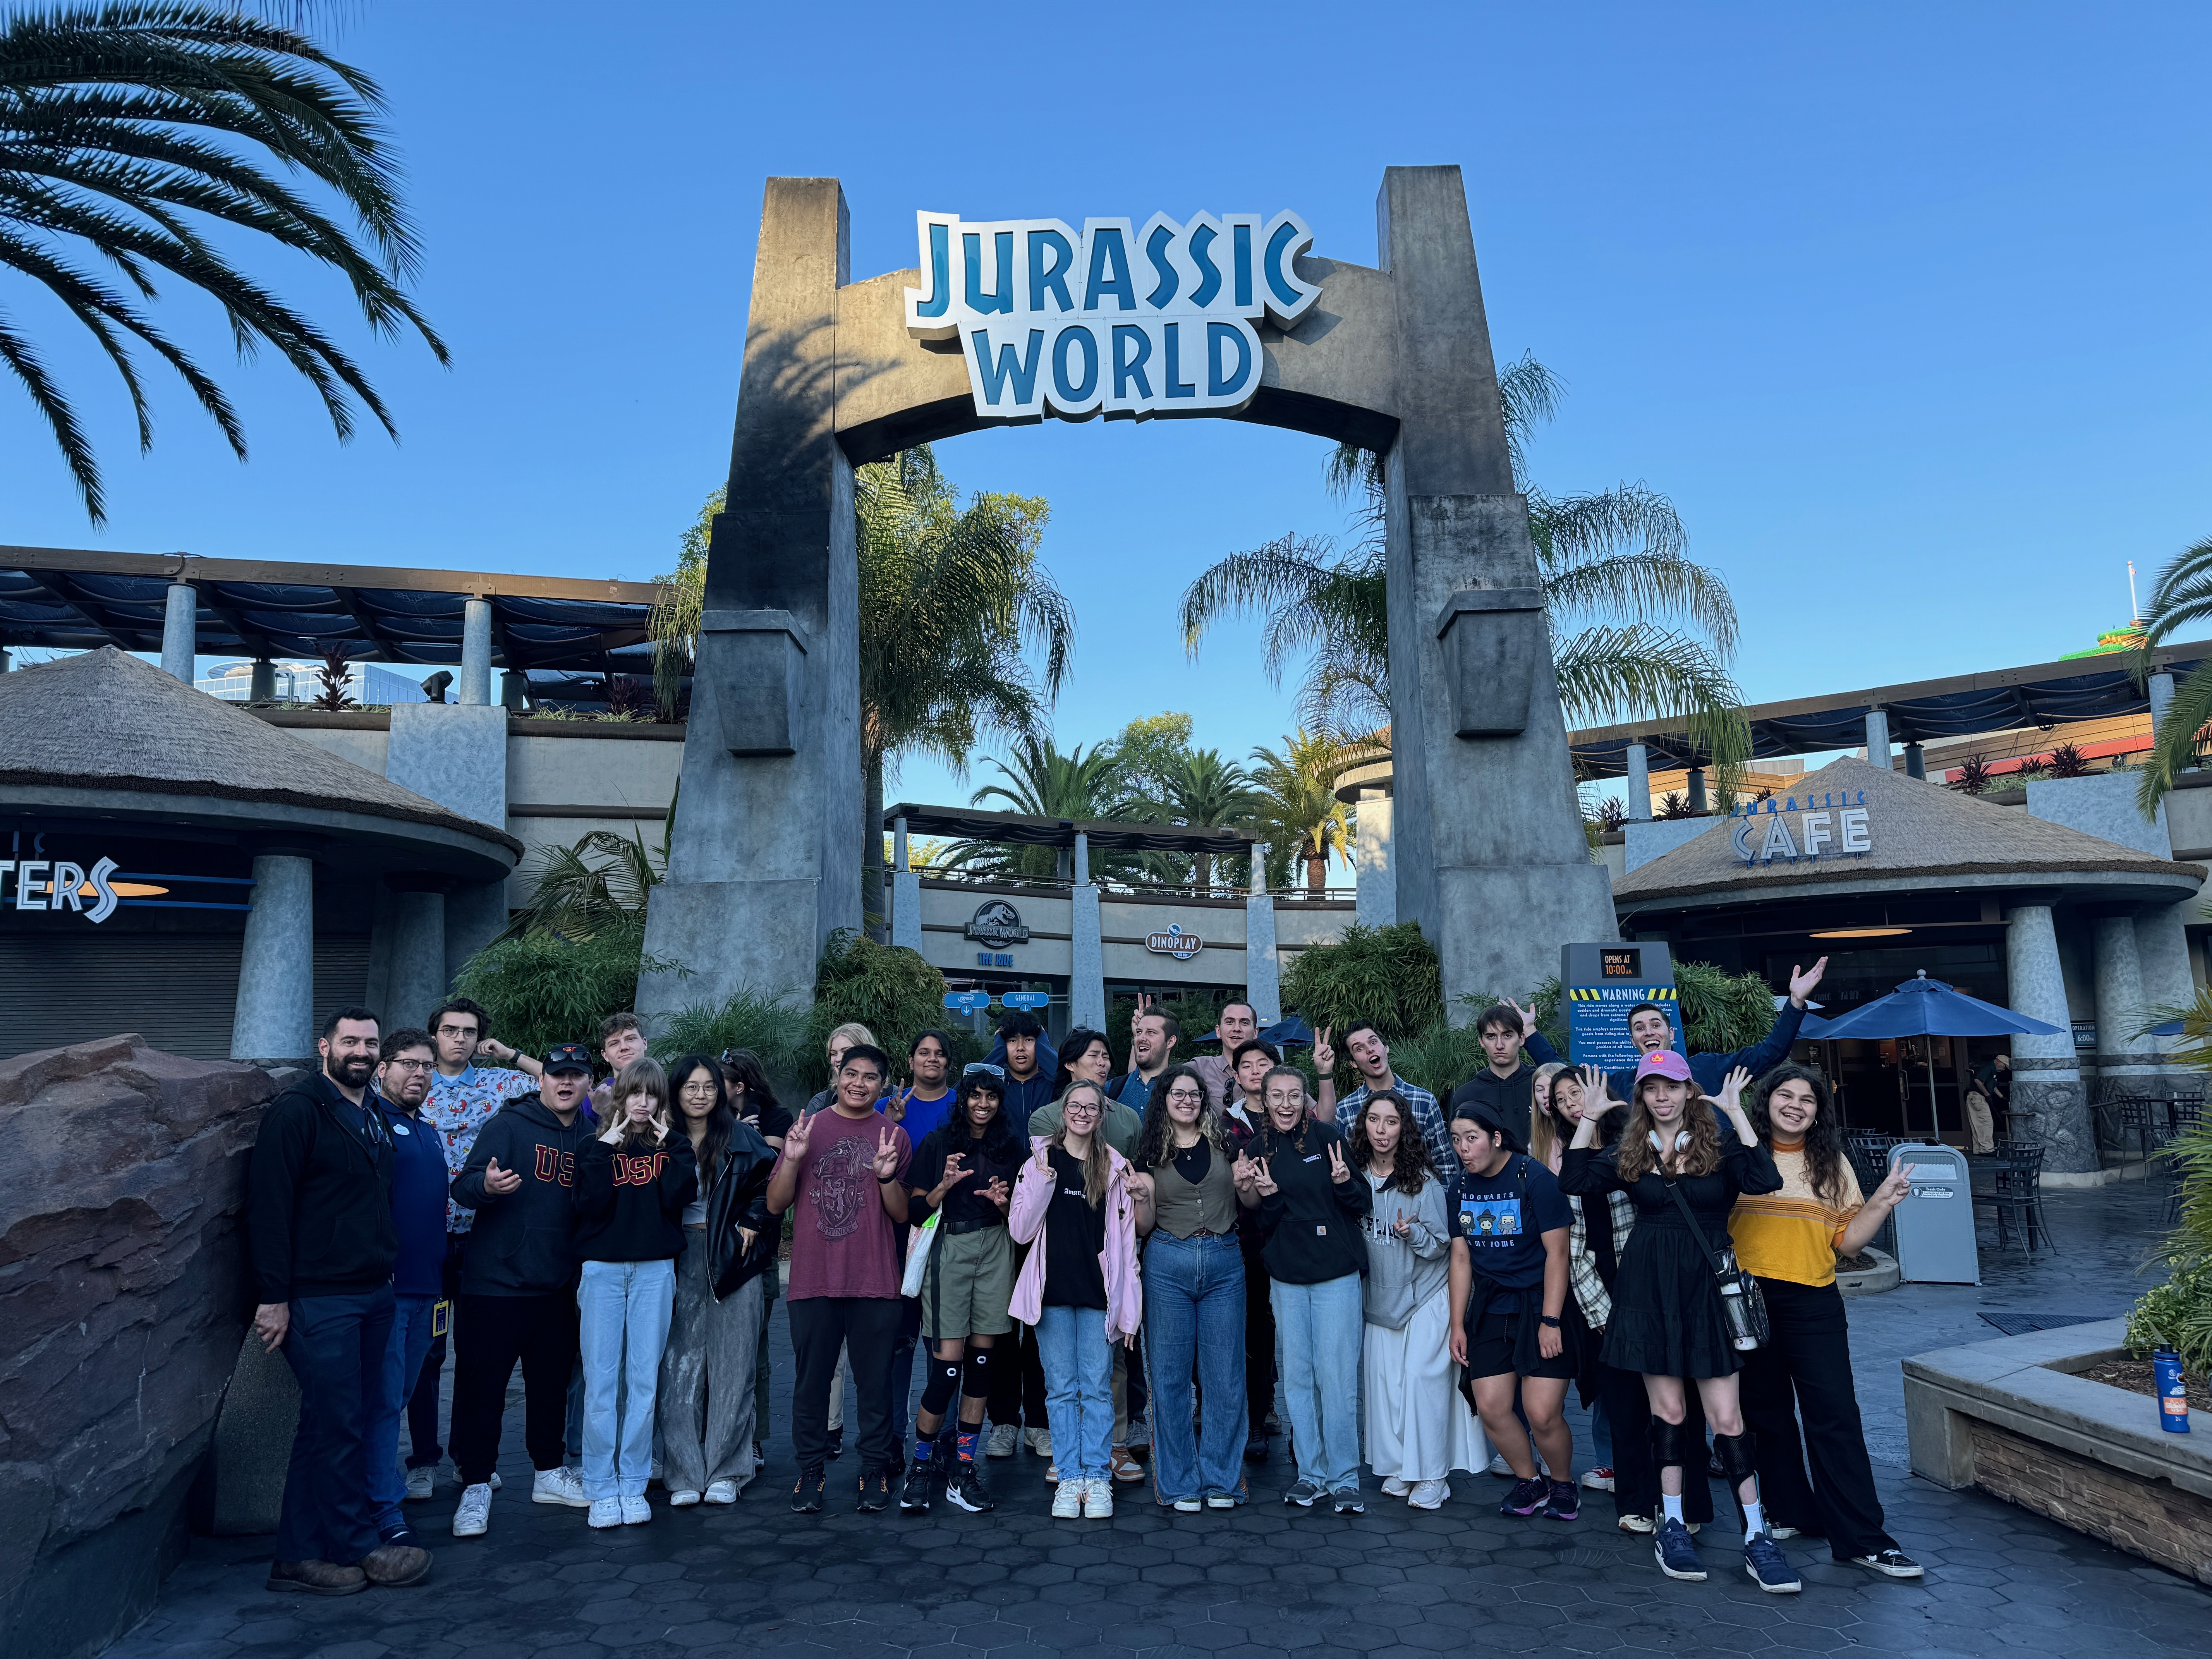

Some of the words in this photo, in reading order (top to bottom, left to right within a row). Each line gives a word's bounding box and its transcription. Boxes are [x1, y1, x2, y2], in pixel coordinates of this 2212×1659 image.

[917, 221, 1304, 317] JURASSIC
[971, 322, 1252, 405] WORLD
[1730, 790, 1865, 817] JURASSIC
[1730, 808, 1872, 860] CAFE
[968, 925, 999, 936] JURASSIC
[1000, 927, 1028, 938] WORLD
[1151, 936, 1196, 950] DINOPLAY
[978, 952, 993, 965] THE
[996, 953, 1013, 967] RIDE
[1605, 955, 1622, 963] OPENS
[1624, 955, 1630, 963] AT
[1602, 988, 1645, 1001] WARNING
[534, 1144, 574, 1187] US
[1462, 1192, 1514, 1200] HOGWARTS
